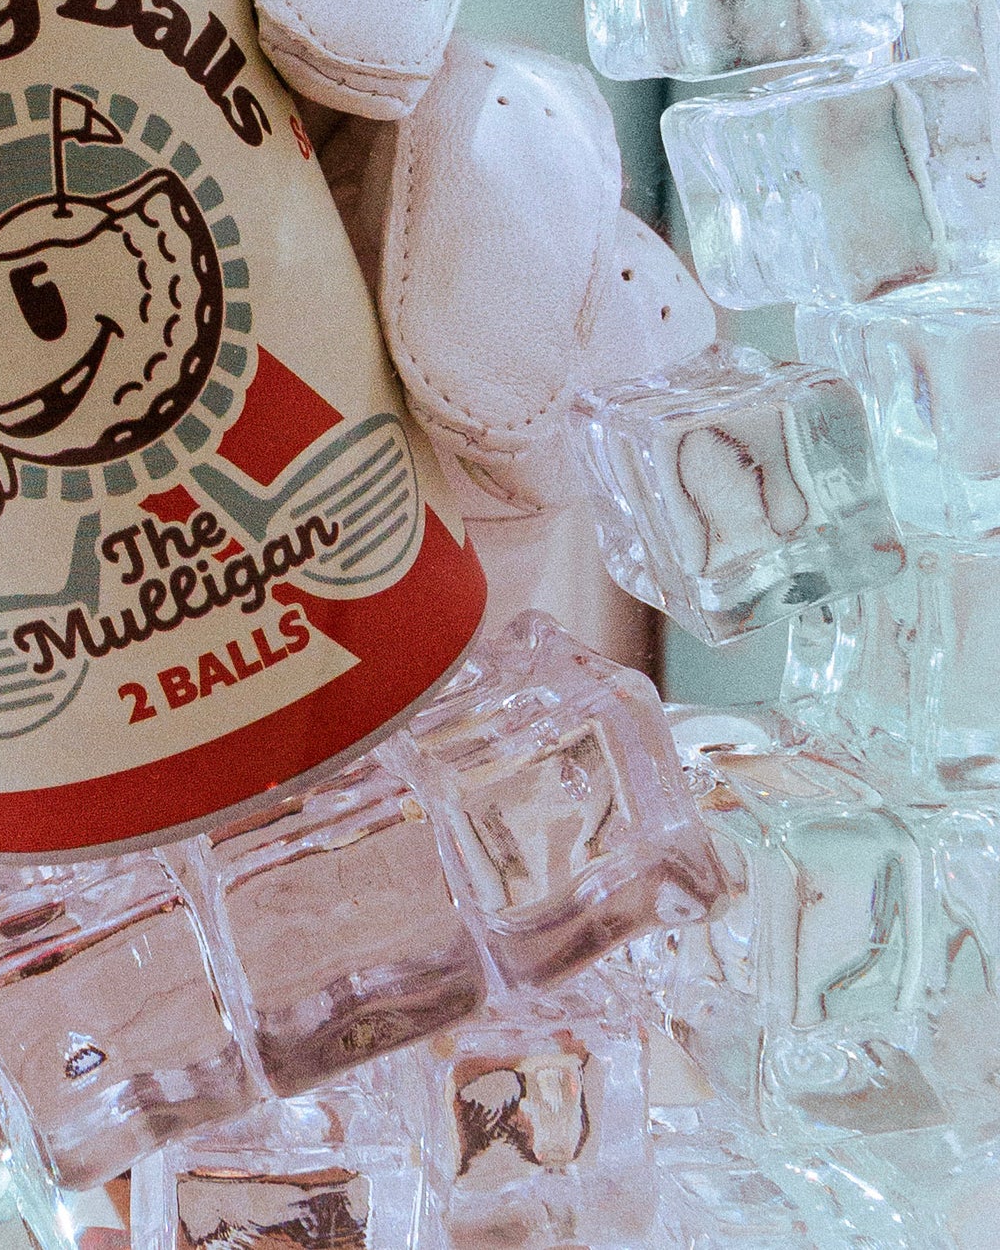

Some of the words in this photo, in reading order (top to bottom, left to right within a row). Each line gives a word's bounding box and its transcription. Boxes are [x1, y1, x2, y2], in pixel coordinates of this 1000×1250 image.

[13, 515, 340, 674] Mulligan
[102, 505, 227, 584] The
[117, 681, 157, 725] 2
[156, 608, 311, 712] BALLS
